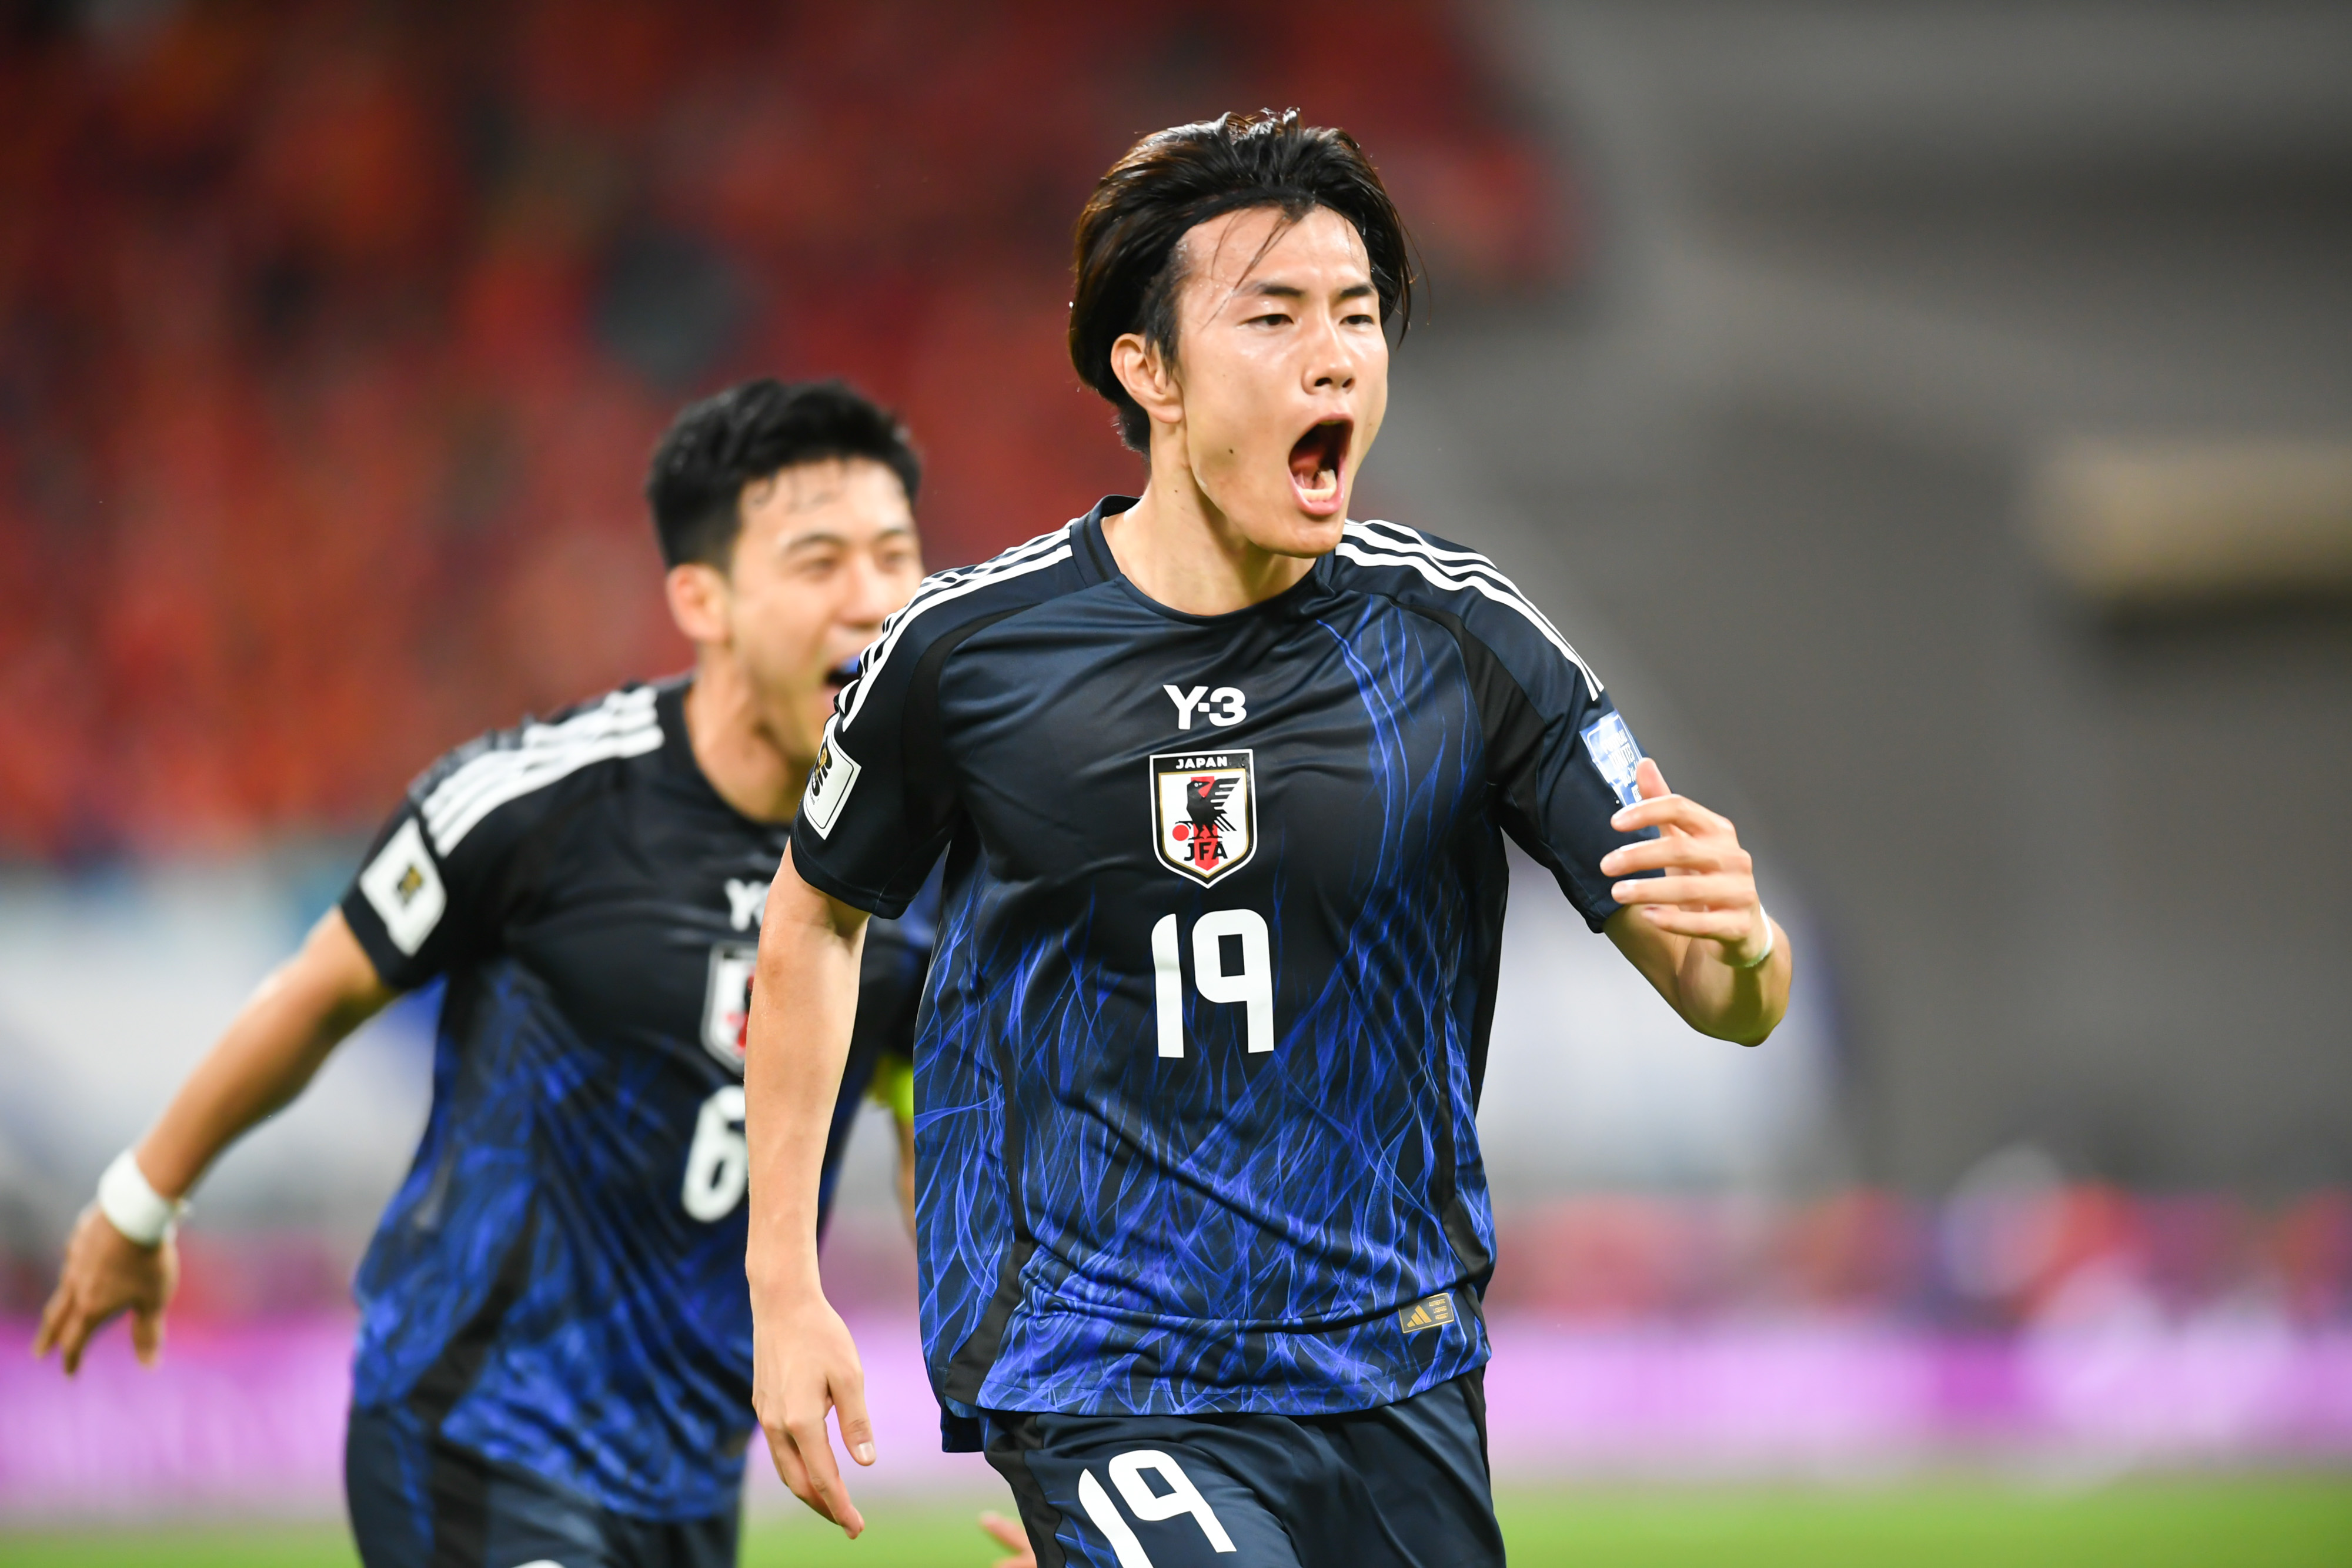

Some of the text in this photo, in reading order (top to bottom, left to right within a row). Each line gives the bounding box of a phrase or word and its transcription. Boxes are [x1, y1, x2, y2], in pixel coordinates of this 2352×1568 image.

[1162, 684, 1247, 730] Y-3
[1176, 756, 1228, 770] JAPAN
[1183, 841, 1228, 861] JFA
[1151, 908, 1274, 1058] 19
[680, 1085, 750, 1222] 6
[1078, 1449, 1237, 1568] 19
